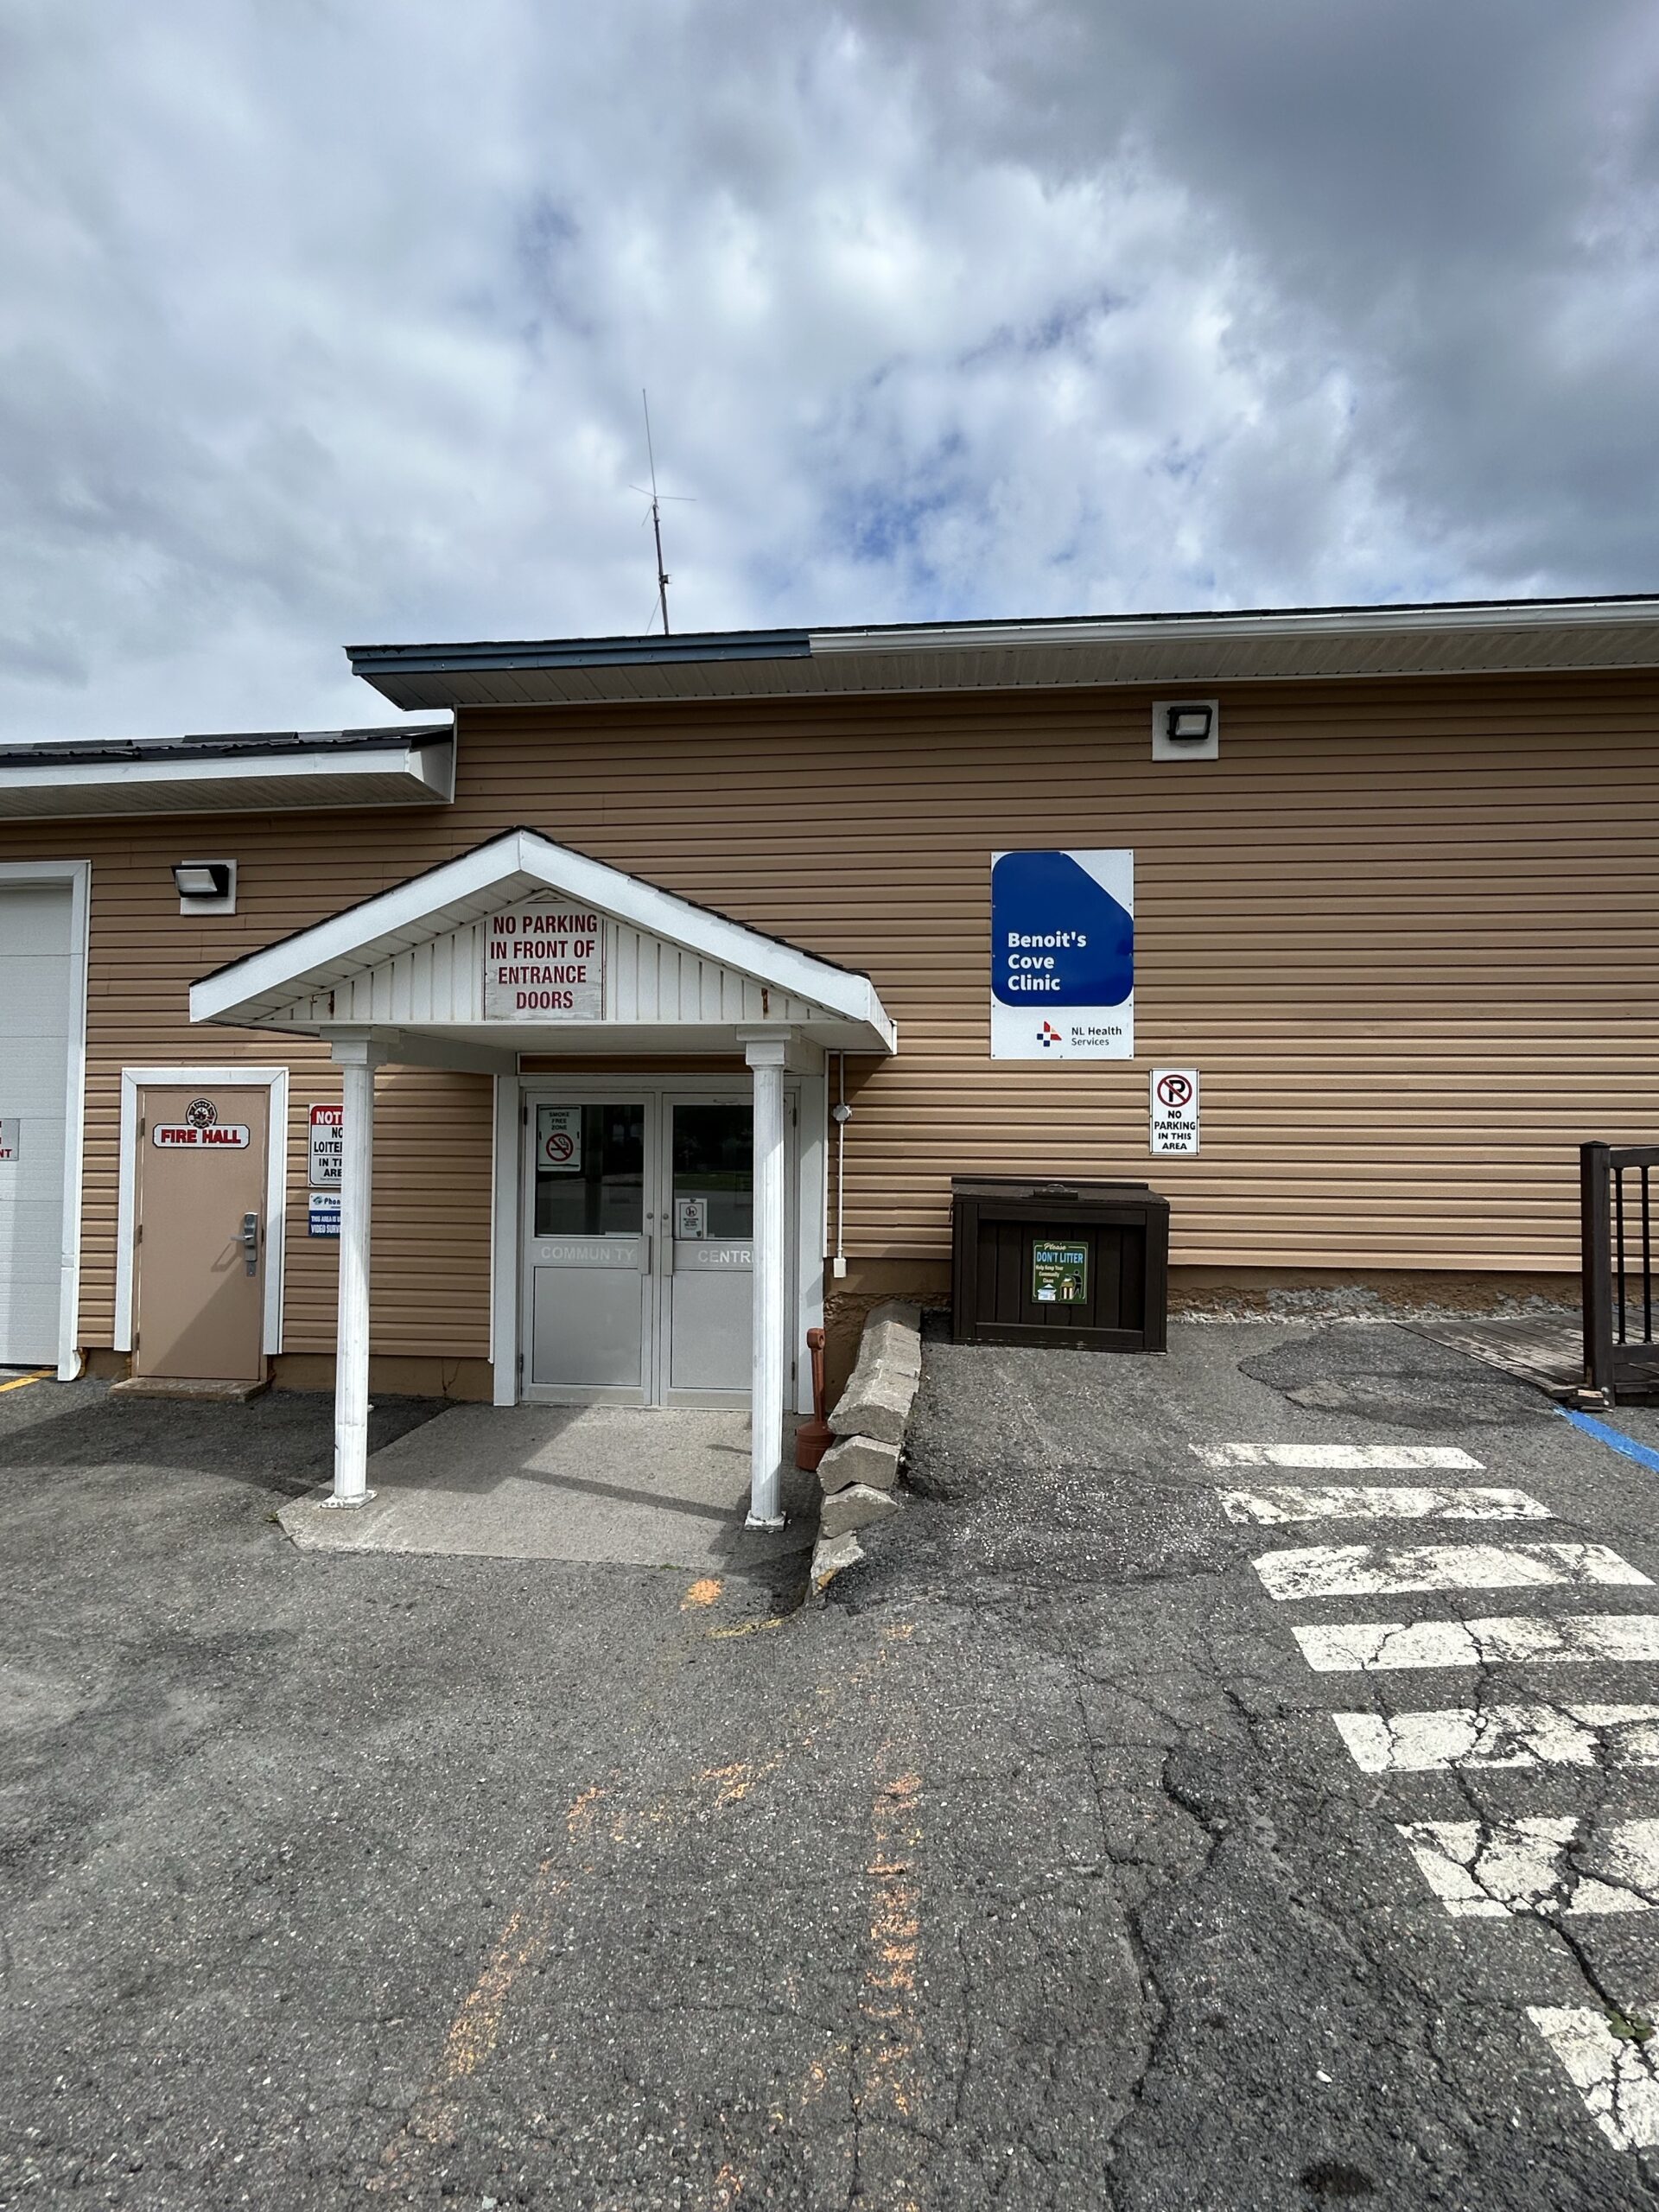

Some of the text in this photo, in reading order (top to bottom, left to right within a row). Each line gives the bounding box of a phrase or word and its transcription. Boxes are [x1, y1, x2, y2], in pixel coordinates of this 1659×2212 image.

[493, 914, 597, 934] NO PARKING
[1007, 931, 1087, 948] Benoit's
[490, 940, 594, 959] IN FRONT OF
[1007, 954, 1055, 969] Cove
[498, 965, 587, 984] ENTRANCE
[1007, 974, 1061, 991] Clinic
[517, 990, 574, 1009] DOORS
[1071, 1026, 1122, 1036] NL Health
[1071, 1037, 1109, 1046] Services
[1167, 1110, 1182, 1119] NO
[1154, 1122, 1196, 1130] PARKING
[161, 1128, 241, 1144] FIRE HALL
[319, 1158, 329, 1166] IN
[323, 1168, 342, 1177] ARE
[324, 1197, 341, 1205] Phon
[541, 1246, 753, 1263] COMMUNTY CENTR
[1037, 1251, 1084, 1263] DON'T LITTER
